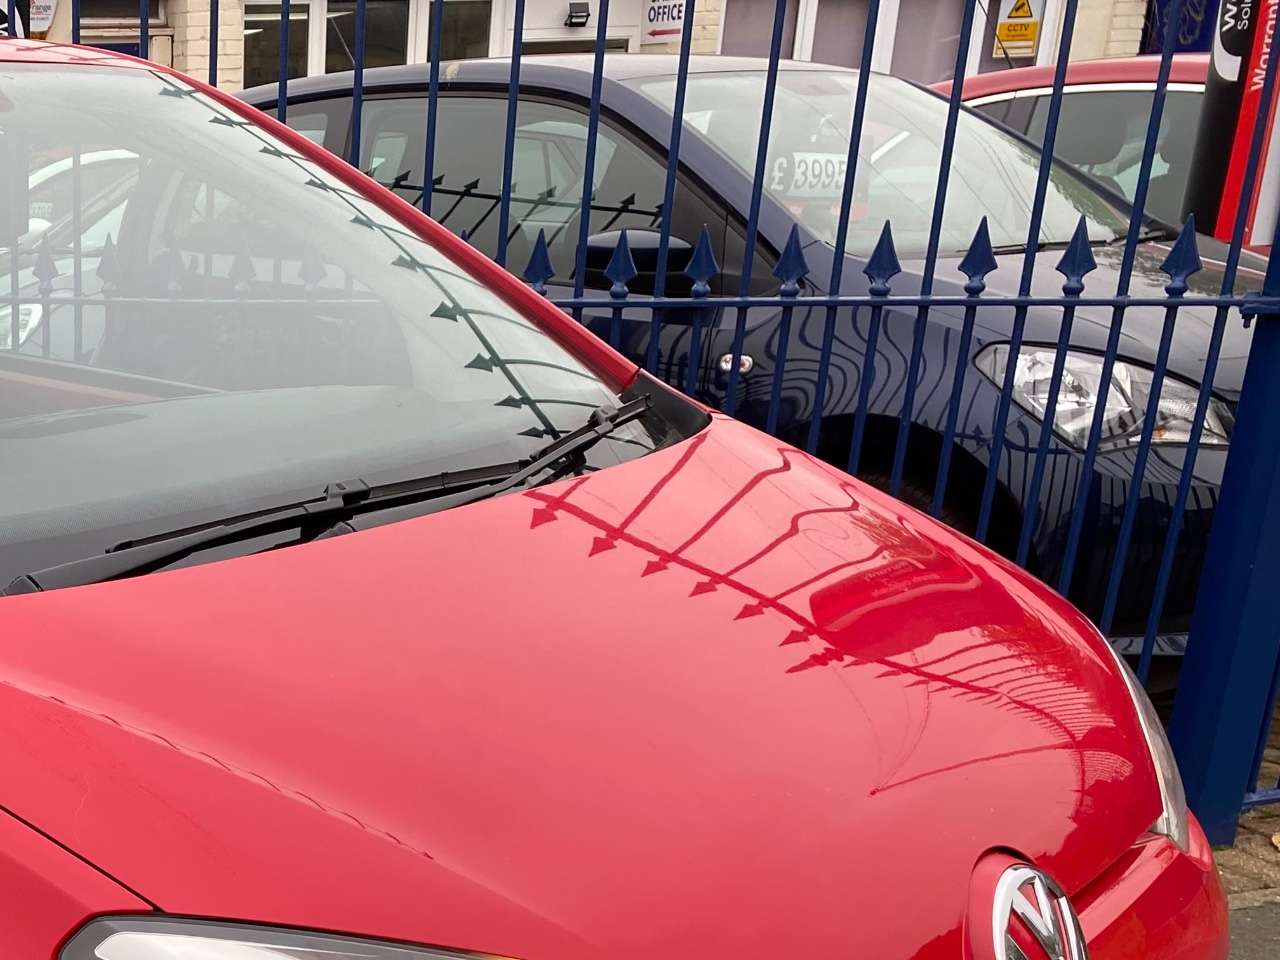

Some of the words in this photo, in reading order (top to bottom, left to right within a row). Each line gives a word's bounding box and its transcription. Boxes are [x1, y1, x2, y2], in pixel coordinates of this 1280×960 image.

[648, 4, 684, 23] OFFICE
[1007, 23, 1030, 33] CCTV
[1250, 0, 1280, 91] Warran
